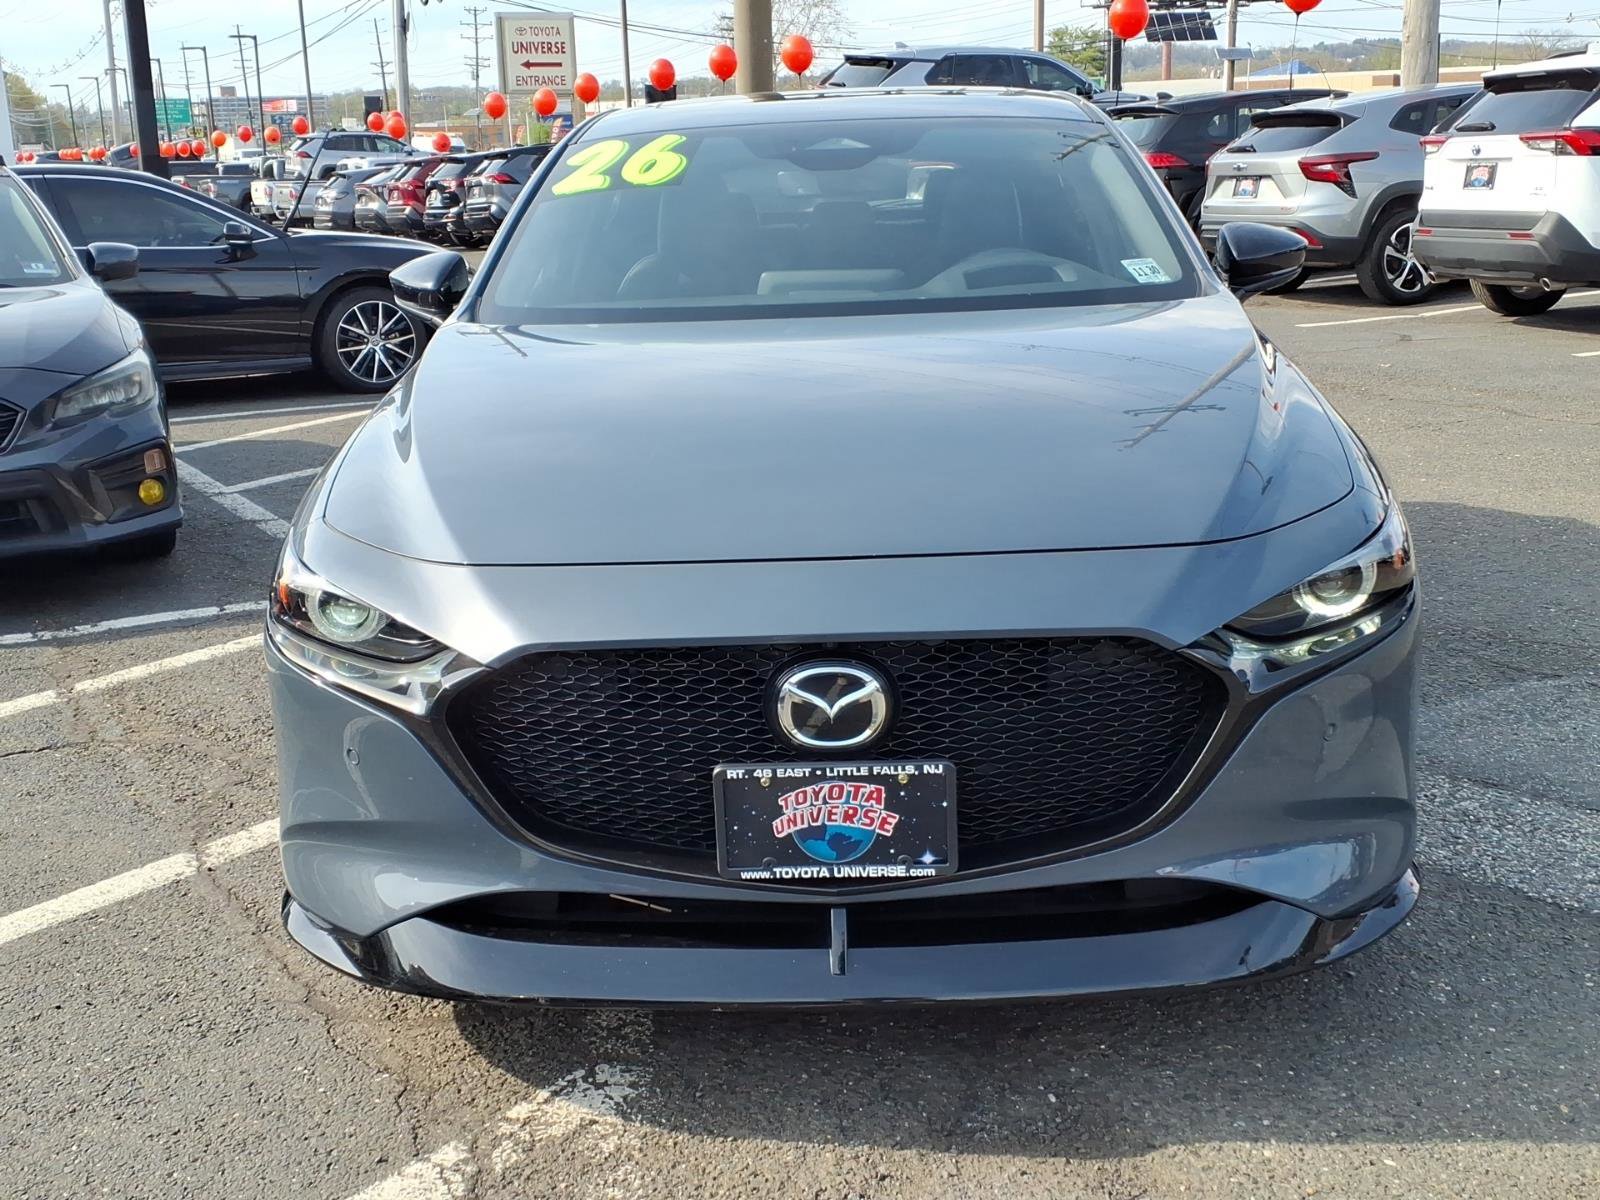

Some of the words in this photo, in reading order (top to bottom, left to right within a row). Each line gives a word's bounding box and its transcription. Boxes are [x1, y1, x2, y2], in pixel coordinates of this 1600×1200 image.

[529, 26, 561, 37] TOYOTA
[512, 41, 566, 54] UNIVERSE
[516, 75, 567, 86] ENTRANCE
[551, 134, 687, 196] 26
[726, 769, 749, 779] RT.
[753, 768, 772, 778] 46
[776, 768, 811, 778] EAST
[826, 766, 869, 777] LITTLE
[873, 765, 919, 776] FALLS,
[923, 764, 943, 774] NJ
[778, 782, 886, 812] TOYOTA
[772, 803, 900, 838] UNIVERSE
[740, 867, 830, 880] www.TOYOTA
[834, 865, 936, 878] UNIVERSE.com
